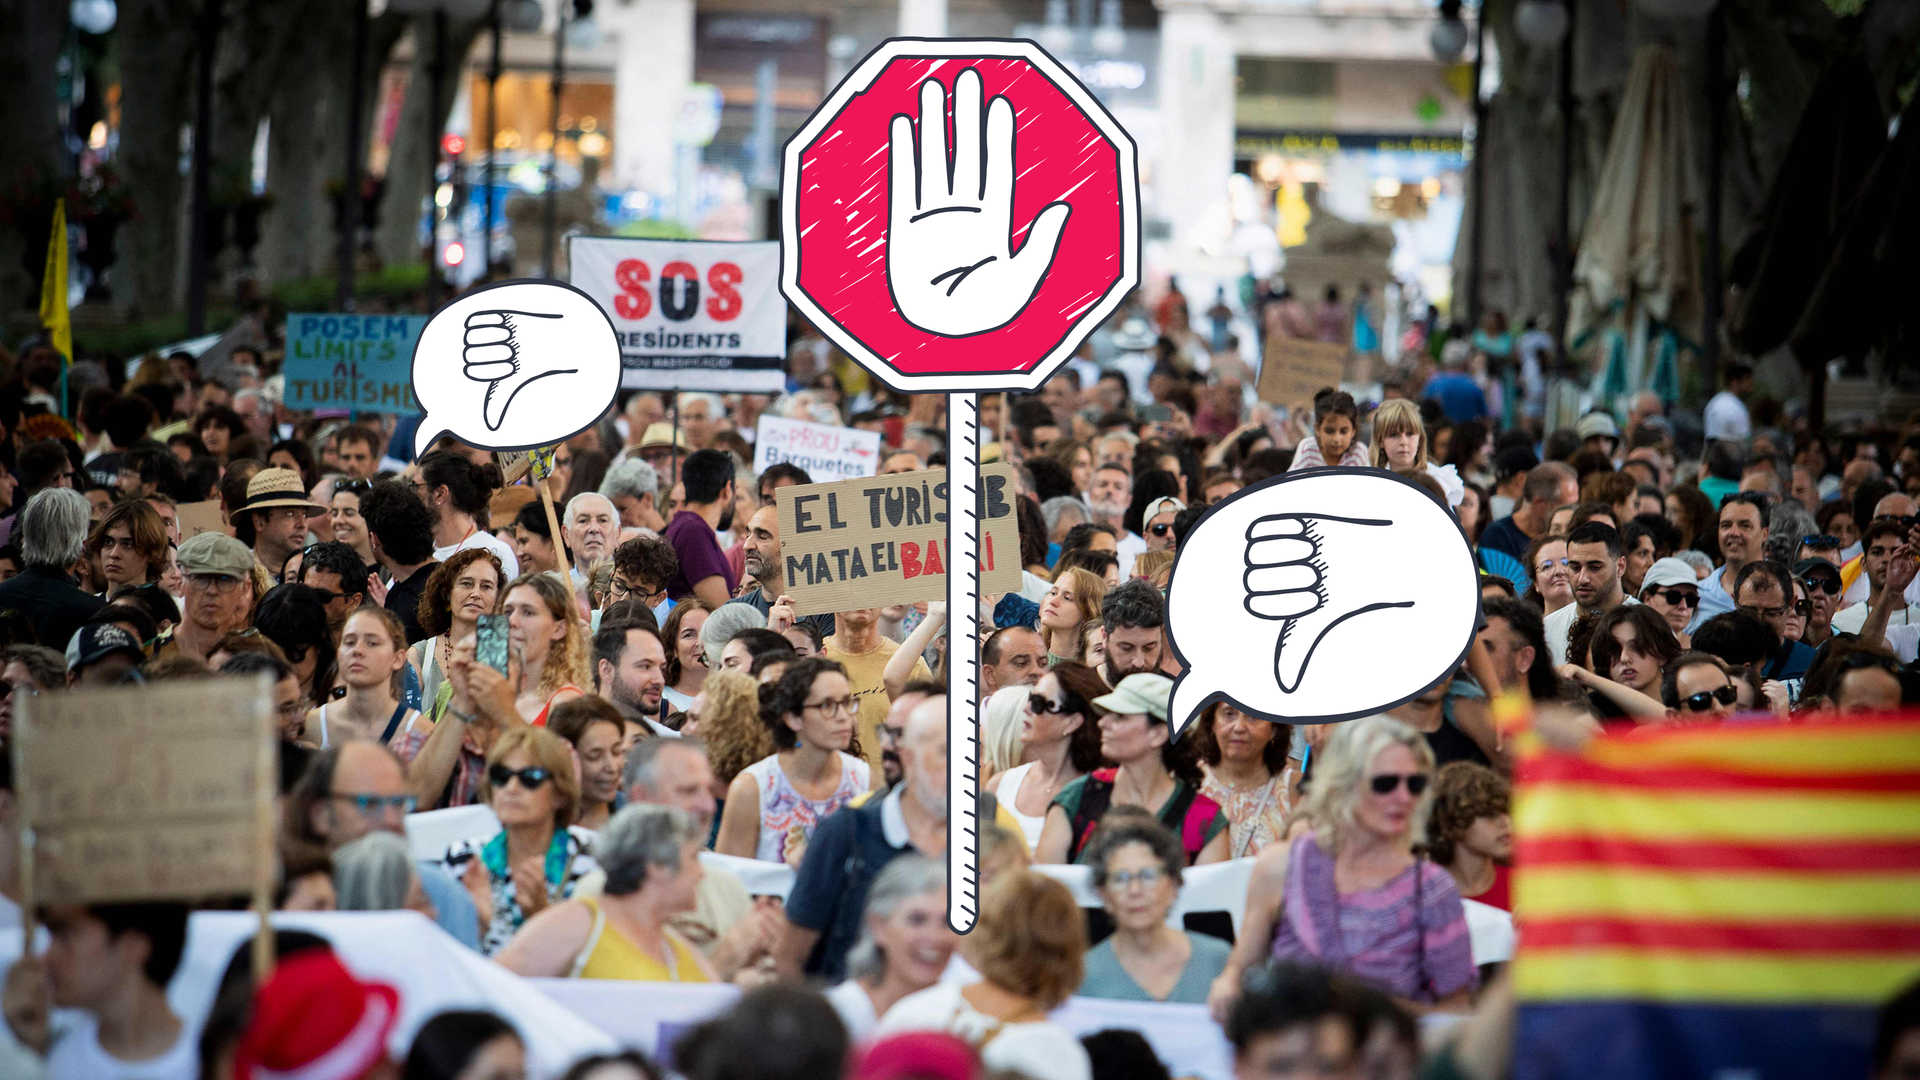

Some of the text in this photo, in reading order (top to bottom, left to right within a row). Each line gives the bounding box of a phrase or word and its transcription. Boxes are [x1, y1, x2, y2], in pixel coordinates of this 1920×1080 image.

[613, 258, 744, 323] SOS
[301, 315, 408, 340] POSEM
[333, 362, 364, 380] AL
[788, 427, 840, 454] PROU
[765, 446, 866, 476] Barquetes
[794, 475, 1010, 534] EL TURISE
[786, 531, 994, 587] MATA EL BAI
